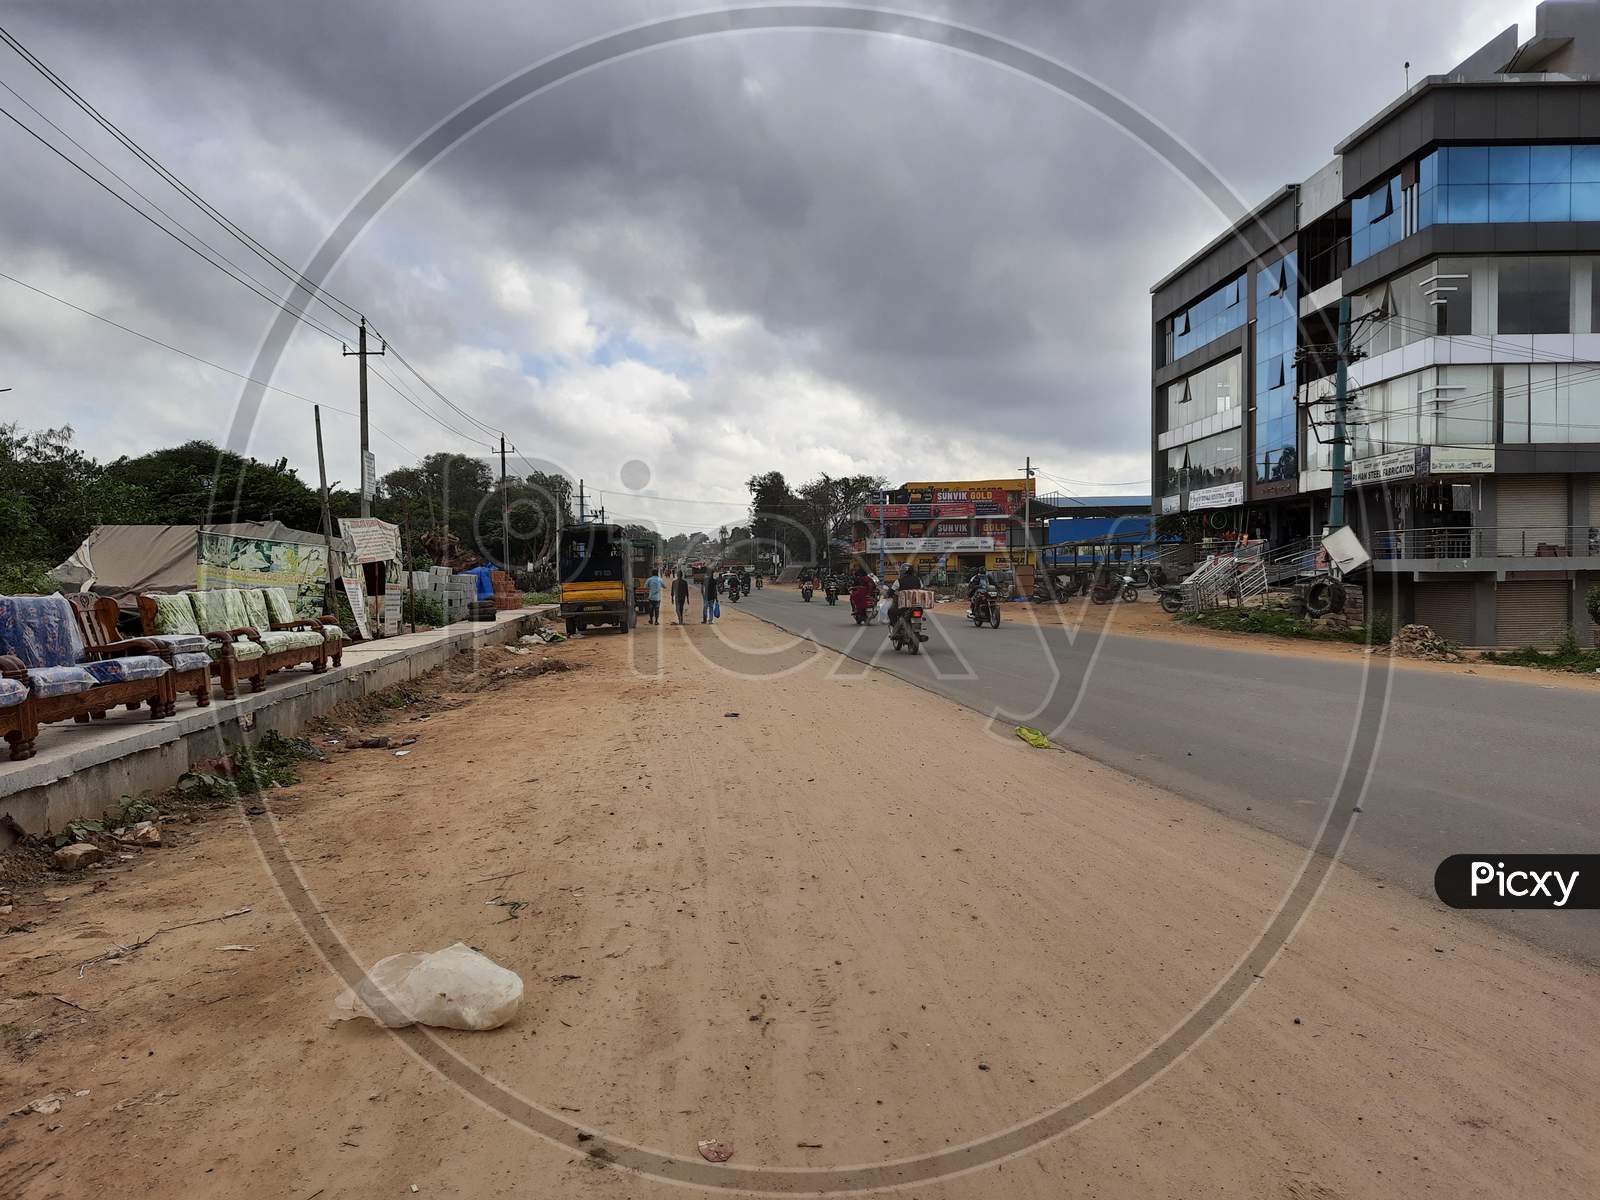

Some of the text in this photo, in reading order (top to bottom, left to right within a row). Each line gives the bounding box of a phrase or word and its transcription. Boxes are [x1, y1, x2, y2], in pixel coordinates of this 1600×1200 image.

[1368, 469, 1382, 480] STEEL
[1383, 464, 1415, 477] FABRICATION
[937, 491, 993, 500] SUNVIK GOLD
[937, 523, 1007, 533] SUNVIK GOLD
